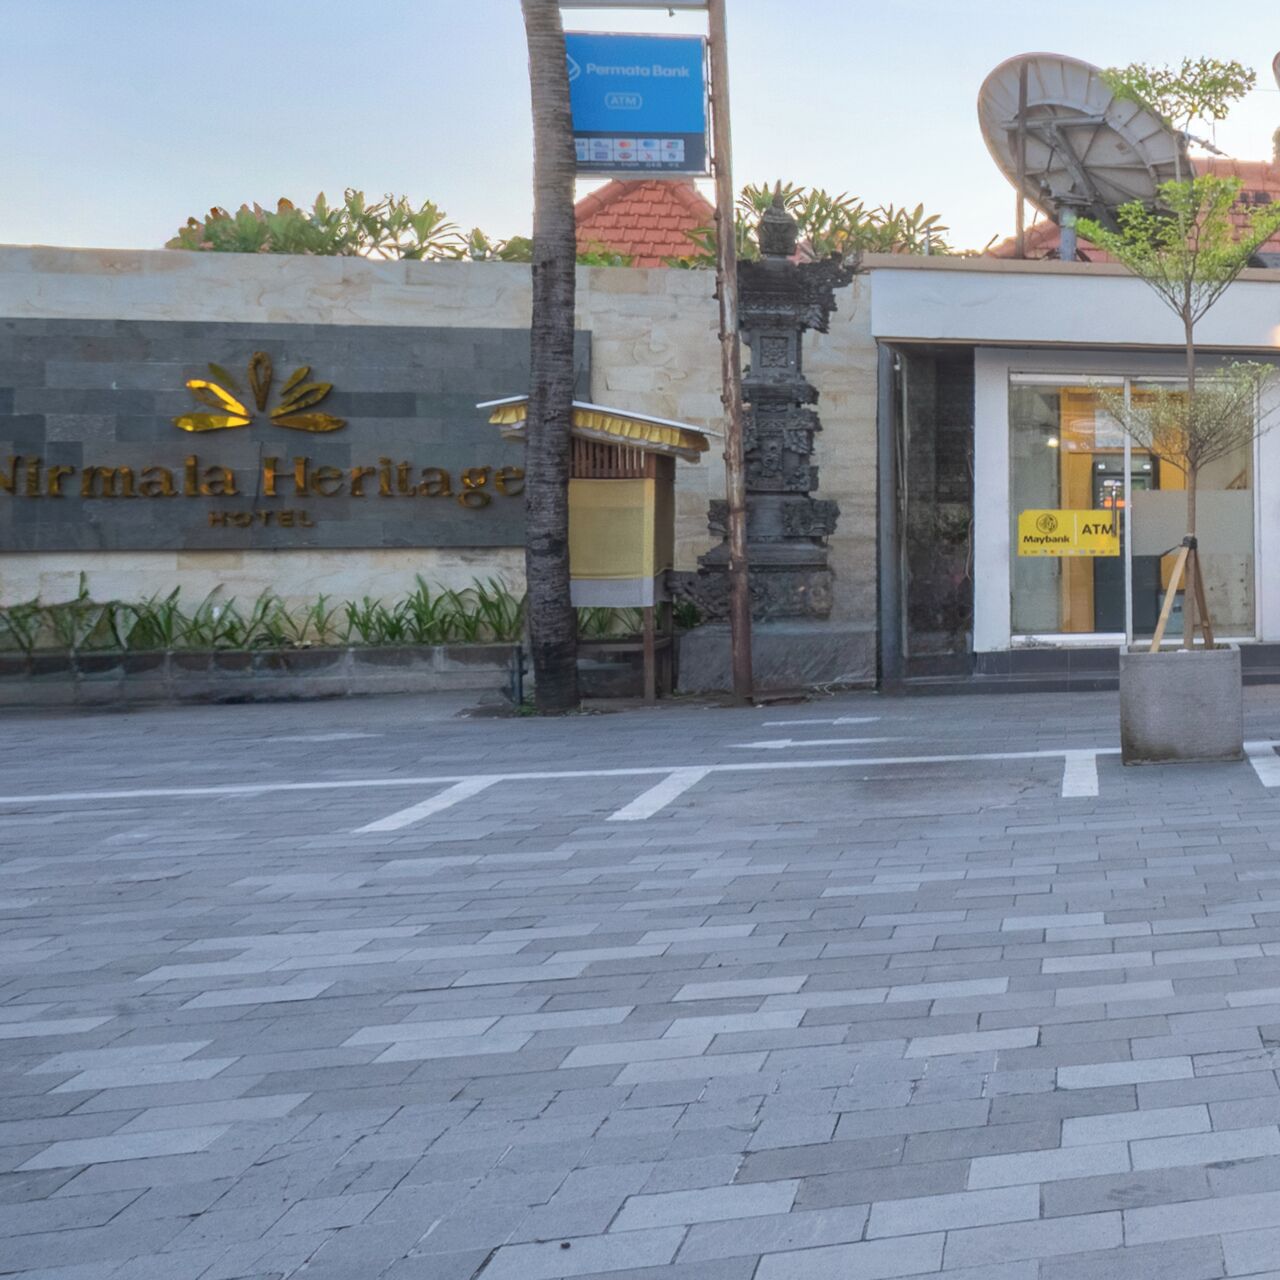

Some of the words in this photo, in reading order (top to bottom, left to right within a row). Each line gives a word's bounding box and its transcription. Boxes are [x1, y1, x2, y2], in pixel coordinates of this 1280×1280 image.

[610, 95, 637, 106] ATM
[263, 456, 525, 509] Heritage
[208, 509, 315, 528] HOTEL
[1081, 523, 1115, 535] ATM
[1023, 535, 1070, 545] Maybank
